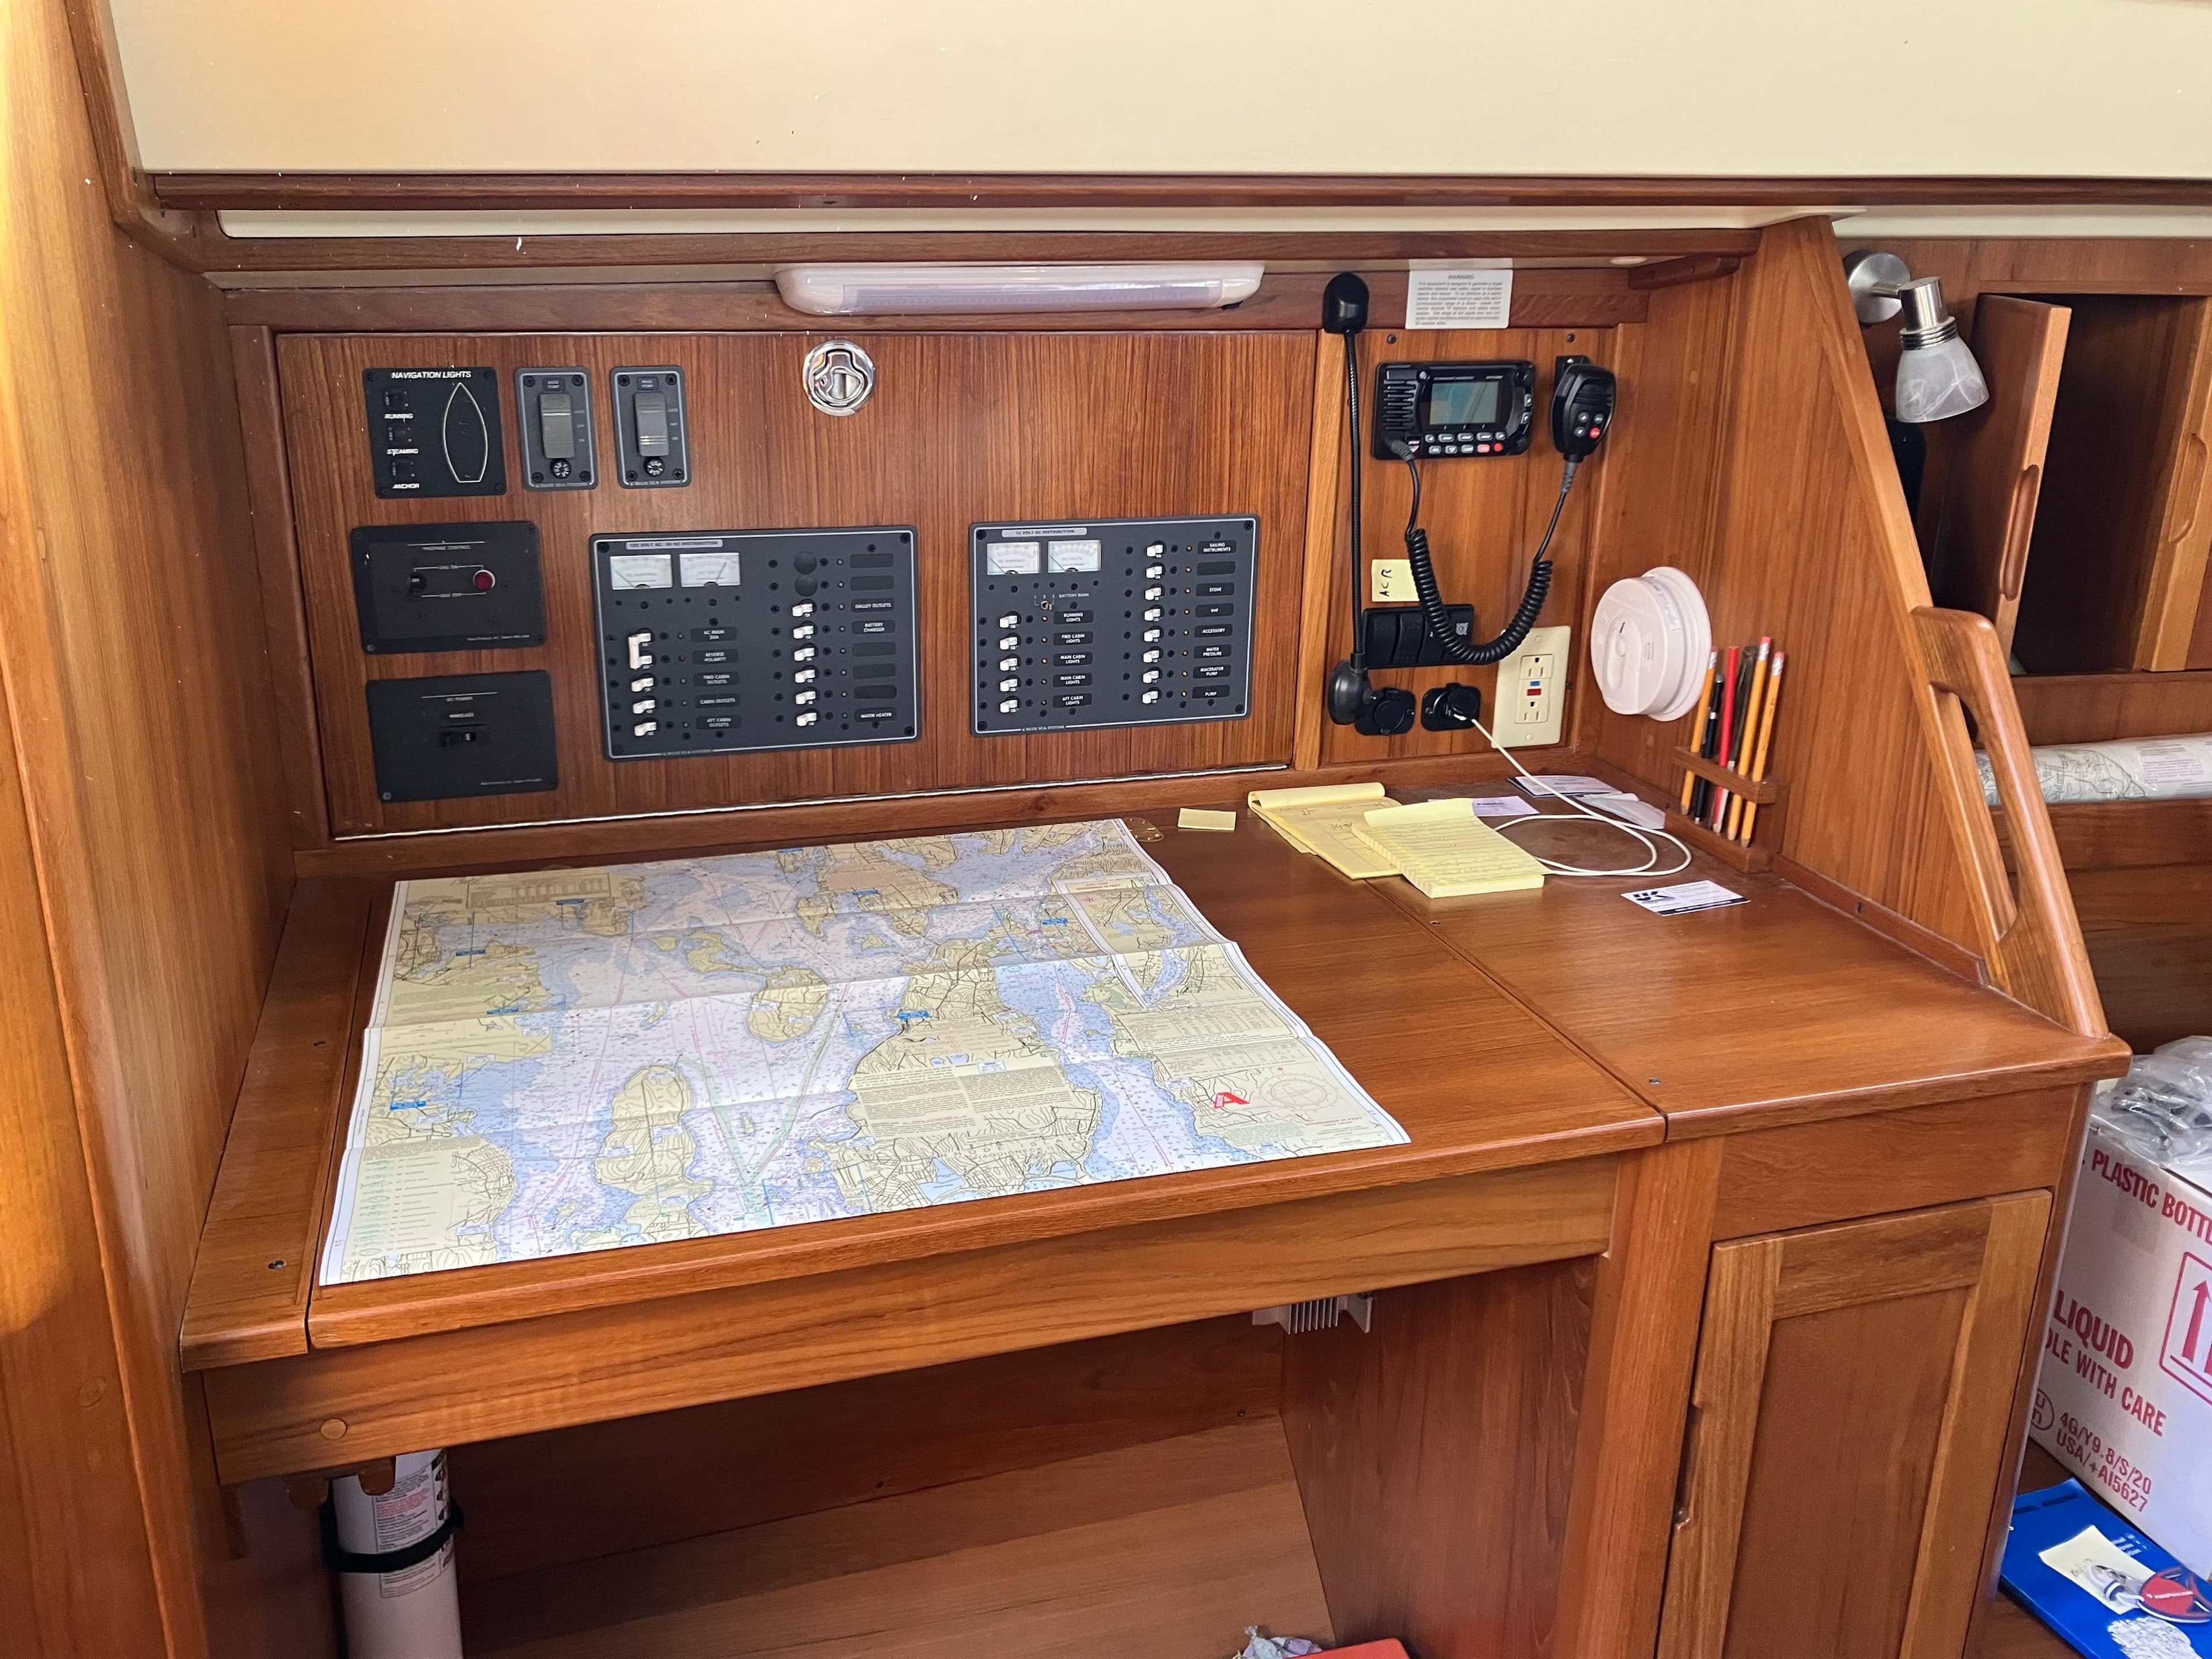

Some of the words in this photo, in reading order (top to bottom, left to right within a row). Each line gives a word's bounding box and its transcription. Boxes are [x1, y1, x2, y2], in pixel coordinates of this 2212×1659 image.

[1379, 569, 1393, 597] ACR
[1215, 1094, 1224, 1107] SIDE
[2092, 1149, 2160, 1209] PLASTIC
[2054, 1290, 2134, 1369] LIQUID
[2075, 1350, 2118, 1399] WITH
[2122, 1387, 2166, 1437] CARE
